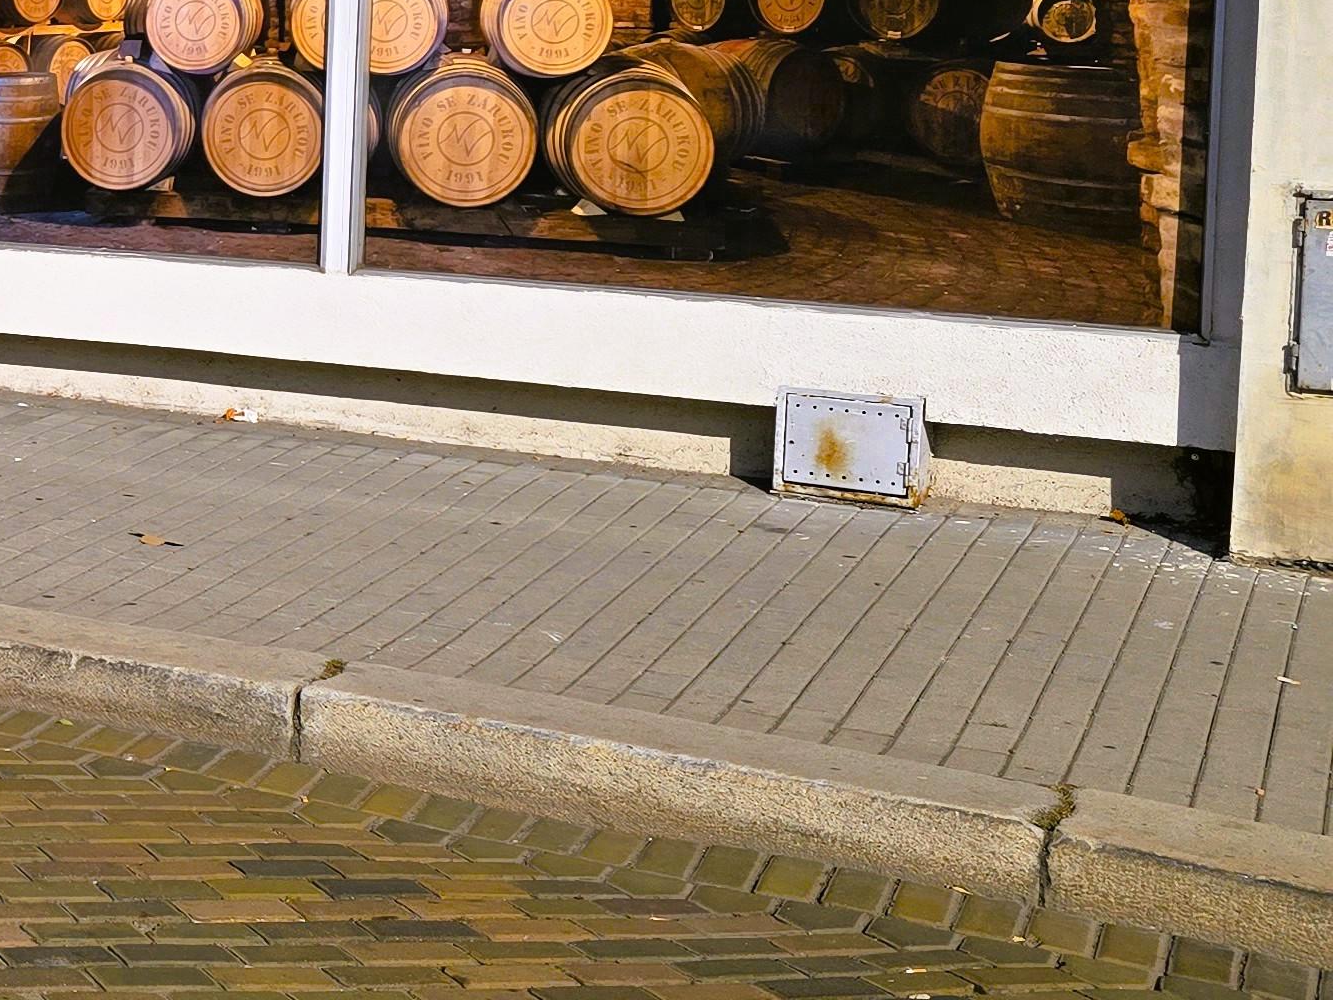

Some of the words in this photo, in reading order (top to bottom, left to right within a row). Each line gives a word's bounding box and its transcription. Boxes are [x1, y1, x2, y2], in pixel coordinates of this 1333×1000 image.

[537, 47, 570, 59] 1991
[237, 91, 255, 109] SE
[437, 96, 457, 112] SE
[103, 156, 135, 169] 1991
[246, 163, 281, 176] 1991
[446, 169, 485, 184] 1991
